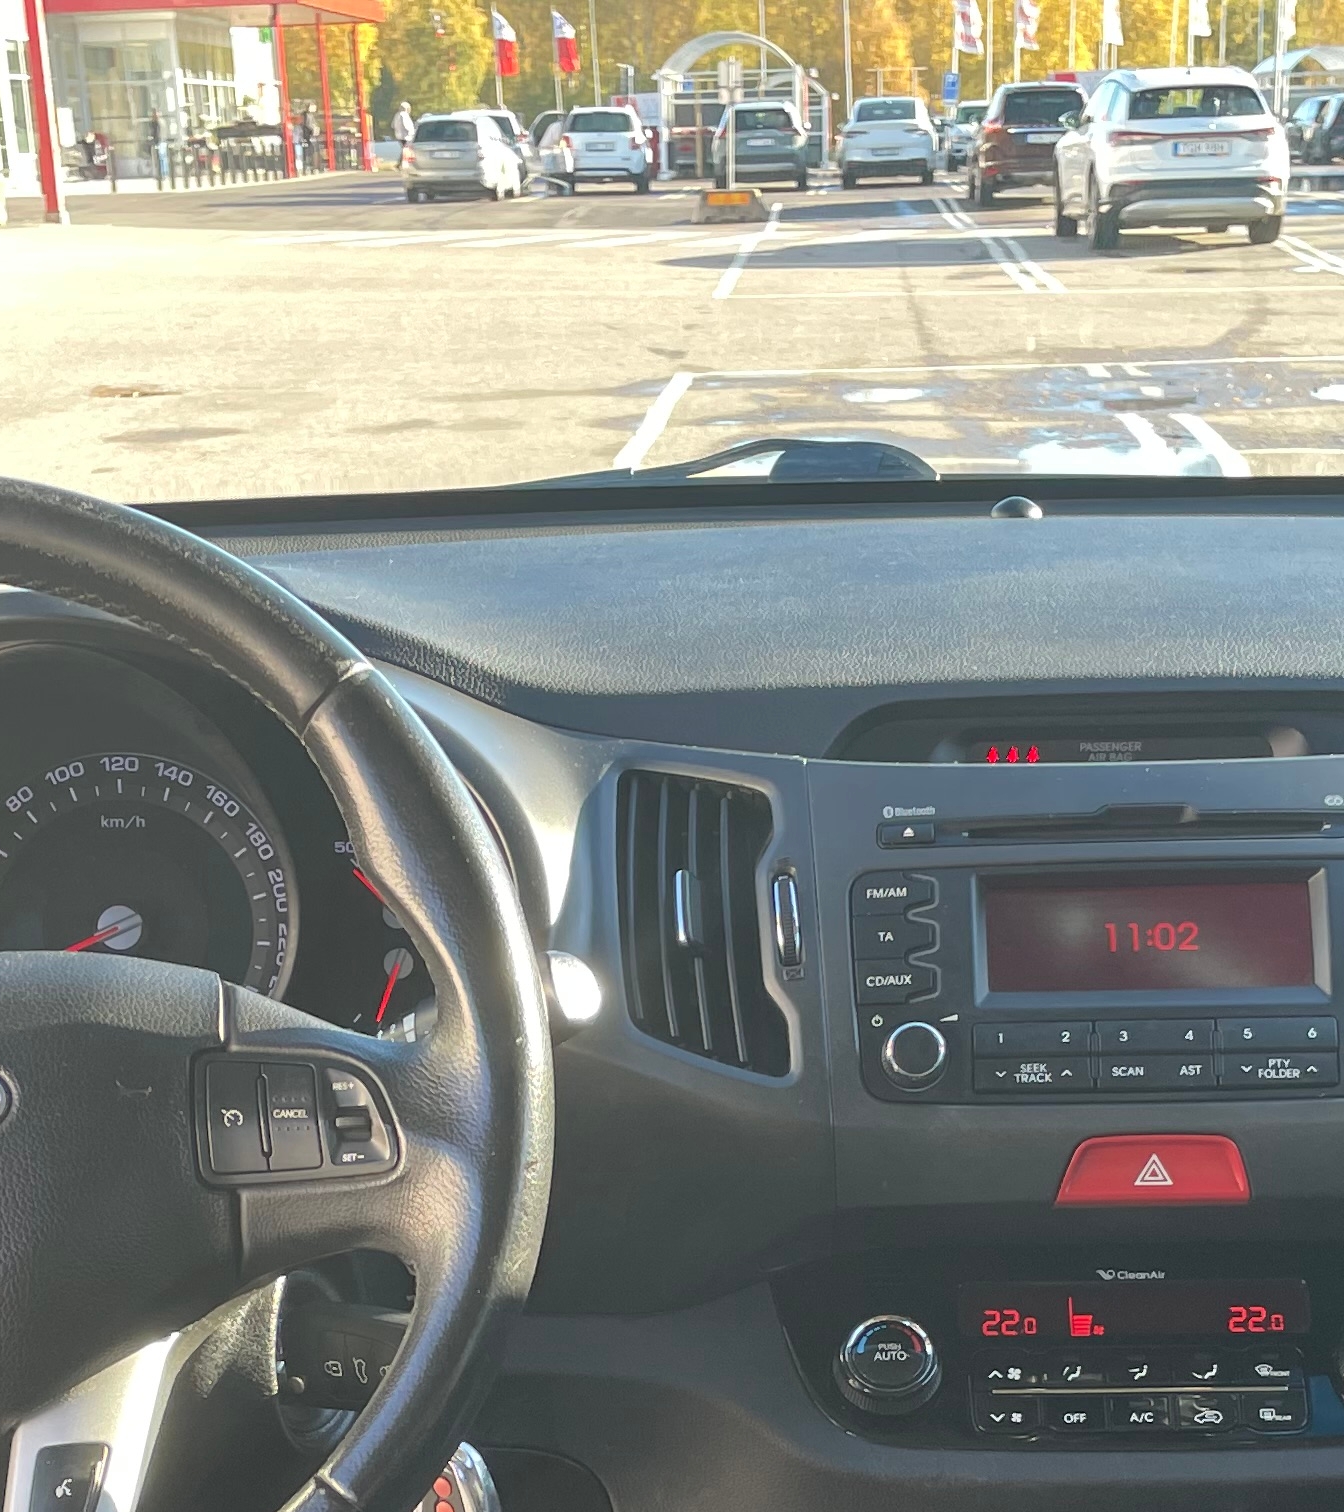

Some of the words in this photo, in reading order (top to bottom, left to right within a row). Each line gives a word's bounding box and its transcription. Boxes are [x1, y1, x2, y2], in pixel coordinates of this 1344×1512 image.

[1079, 741, 1142, 752] PASSENGER
[1088, 752, 1106, 762] AIR
[1109, 752, 1133, 762] BAG
[99, 756, 139, 772] 120
[45, 762, 85, 785] 100
[154, 761, 194, 787] 140
[6, 786, 34, 813] 80
[206, 784, 240, 818] 160
[100, 815, 146, 829] km/h
[245, 822, 275, 861] 180
[267, 868, 288, 913] 200
[866, 887, 907, 899] FM/AM
[877, 931, 894, 942] TA
[1104, 921, 1201, 952] 11:02
[866, 974, 912, 987] CD/AUX
[998, 1032, 1004, 1044] 1
[1061, 1031, 1071, 1043] 2
[1119, 1030, 1129, 1042] 3
[1184, 1030, 1194, 1041] 4
[1242, 1028, 1252, 1040] 5
[1307, 1027, 1317, 1039] 6
[1020, 1063, 1048, 1073] SEEK
[1268, 1058, 1291, 1069] PTY
[1111, 1066, 1145, 1077] SCAN
[1179, 1064, 1203, 1076] AST
[1258, 1068, 1301, 1079] FOLDER
[1013, 1073, 1053, 1084] TRACK
[272, 1108, 309, 1120] CANCEL
[1116, 1270, 1166, 1280] CleanAir
[877, 1343, 902, 1351] PUSH
[873, 1351, 907, 1362] AUTO
[1063, 1412, 1087, 1424] OFF
[1129, 1411, 1154, 1423] A/C
